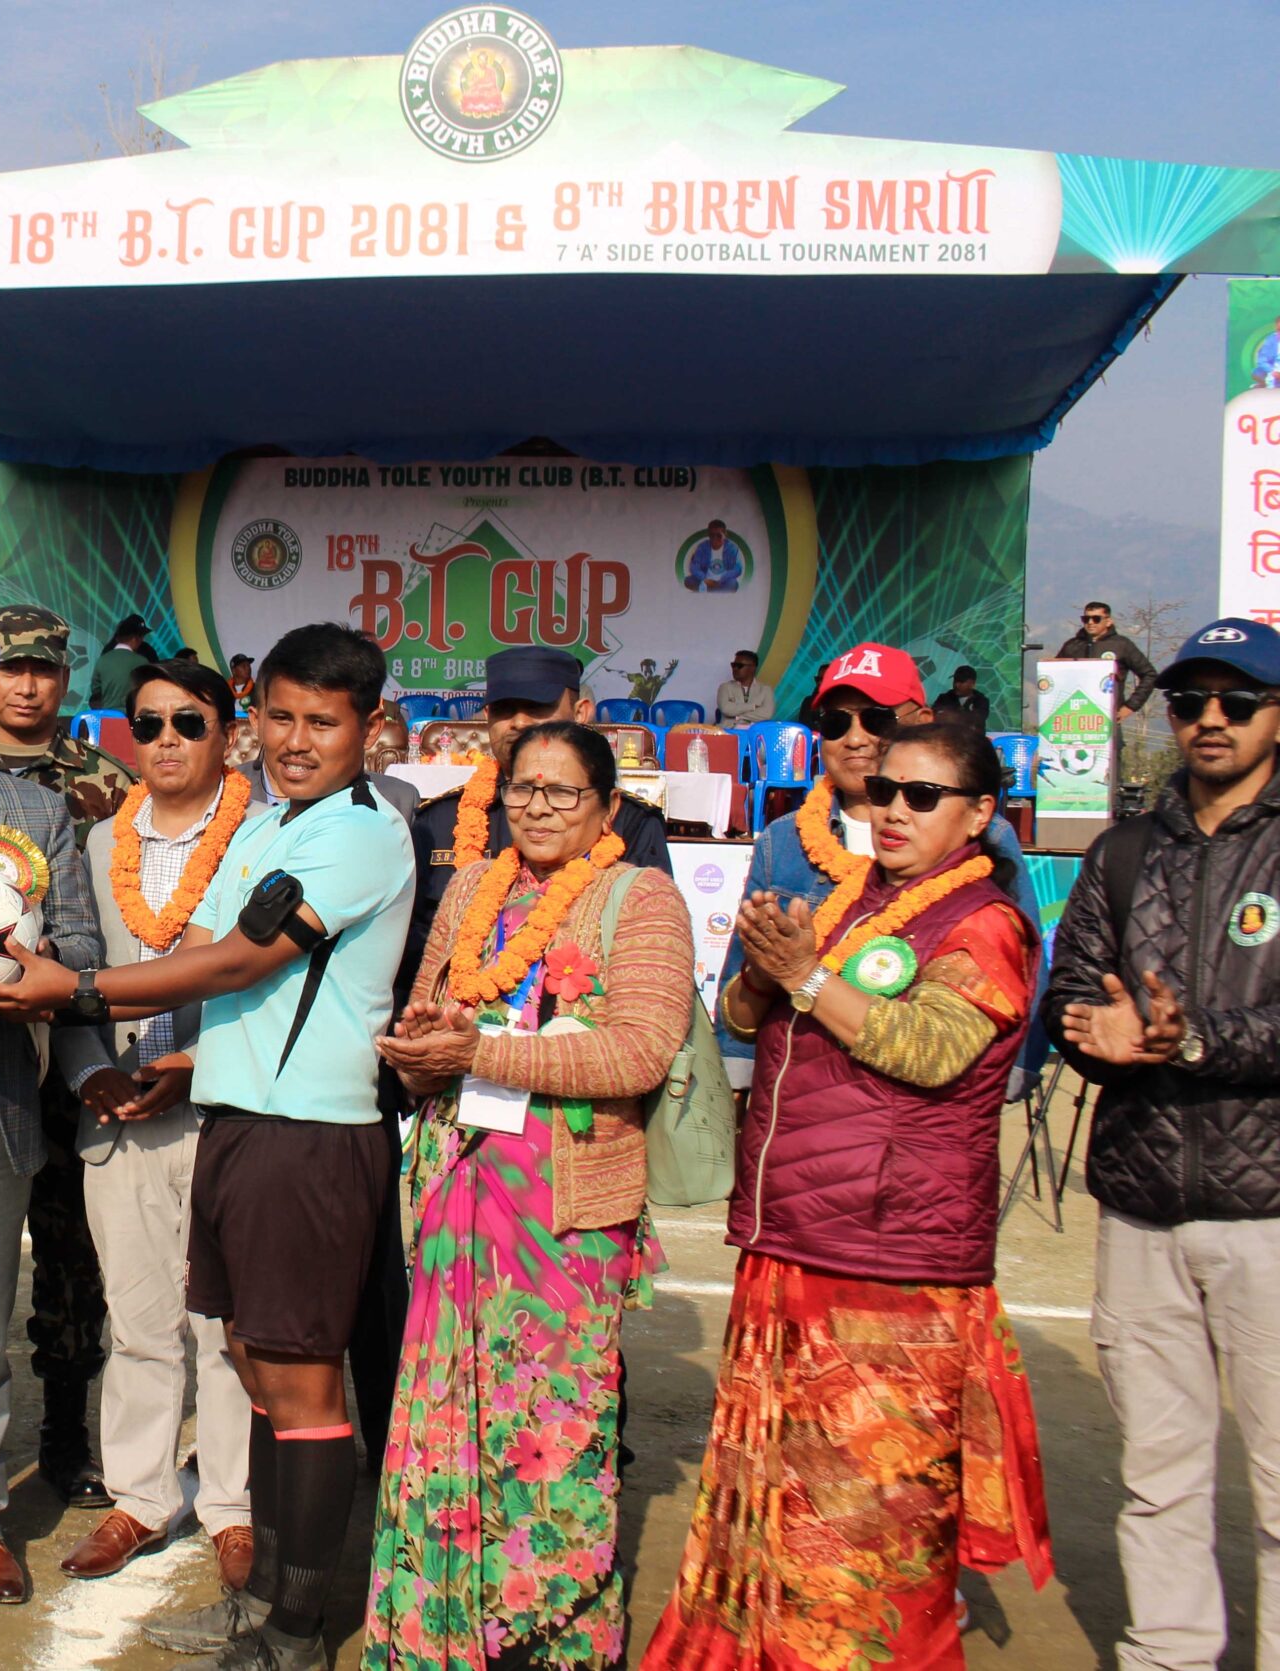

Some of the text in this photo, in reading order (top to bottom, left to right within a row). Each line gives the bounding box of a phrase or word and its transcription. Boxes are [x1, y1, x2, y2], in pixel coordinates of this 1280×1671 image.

[408, 12, 555, 82] BUDDHA TOLE
[413, 97, 549, 155] YOUTH CLUB
[8, 168, 996, 267] 18TH B.T. CUP 2081 & 8TH BIREN SMRITI
[557, 244, 568, 261] 7
[606, 243, 654, 262] SIDE
[663, 243, 772, 262] FOOTBALL
[779, 243, 931, 262] TOURNAMENT
[937, 243, 988, 262] 2081
[284, 466, 697, 492] BUDDHA TOLE YOUTH CLUB (B.T. CLUB)
[236, 523, 299, 553] BUDDHA TOLE
[326, 534, 380, 571] 18TH
[238, 561, 296, 587] YOUTH CLUB
[348, 541, 632, 656] B.T. CUP
[392, 657, 487, 681] & 8TH BIRE
[833, 649, 883, 680] LA
[1078, 714, 1105, 732] CUP
[262, 872, 287, 893] GoRef
